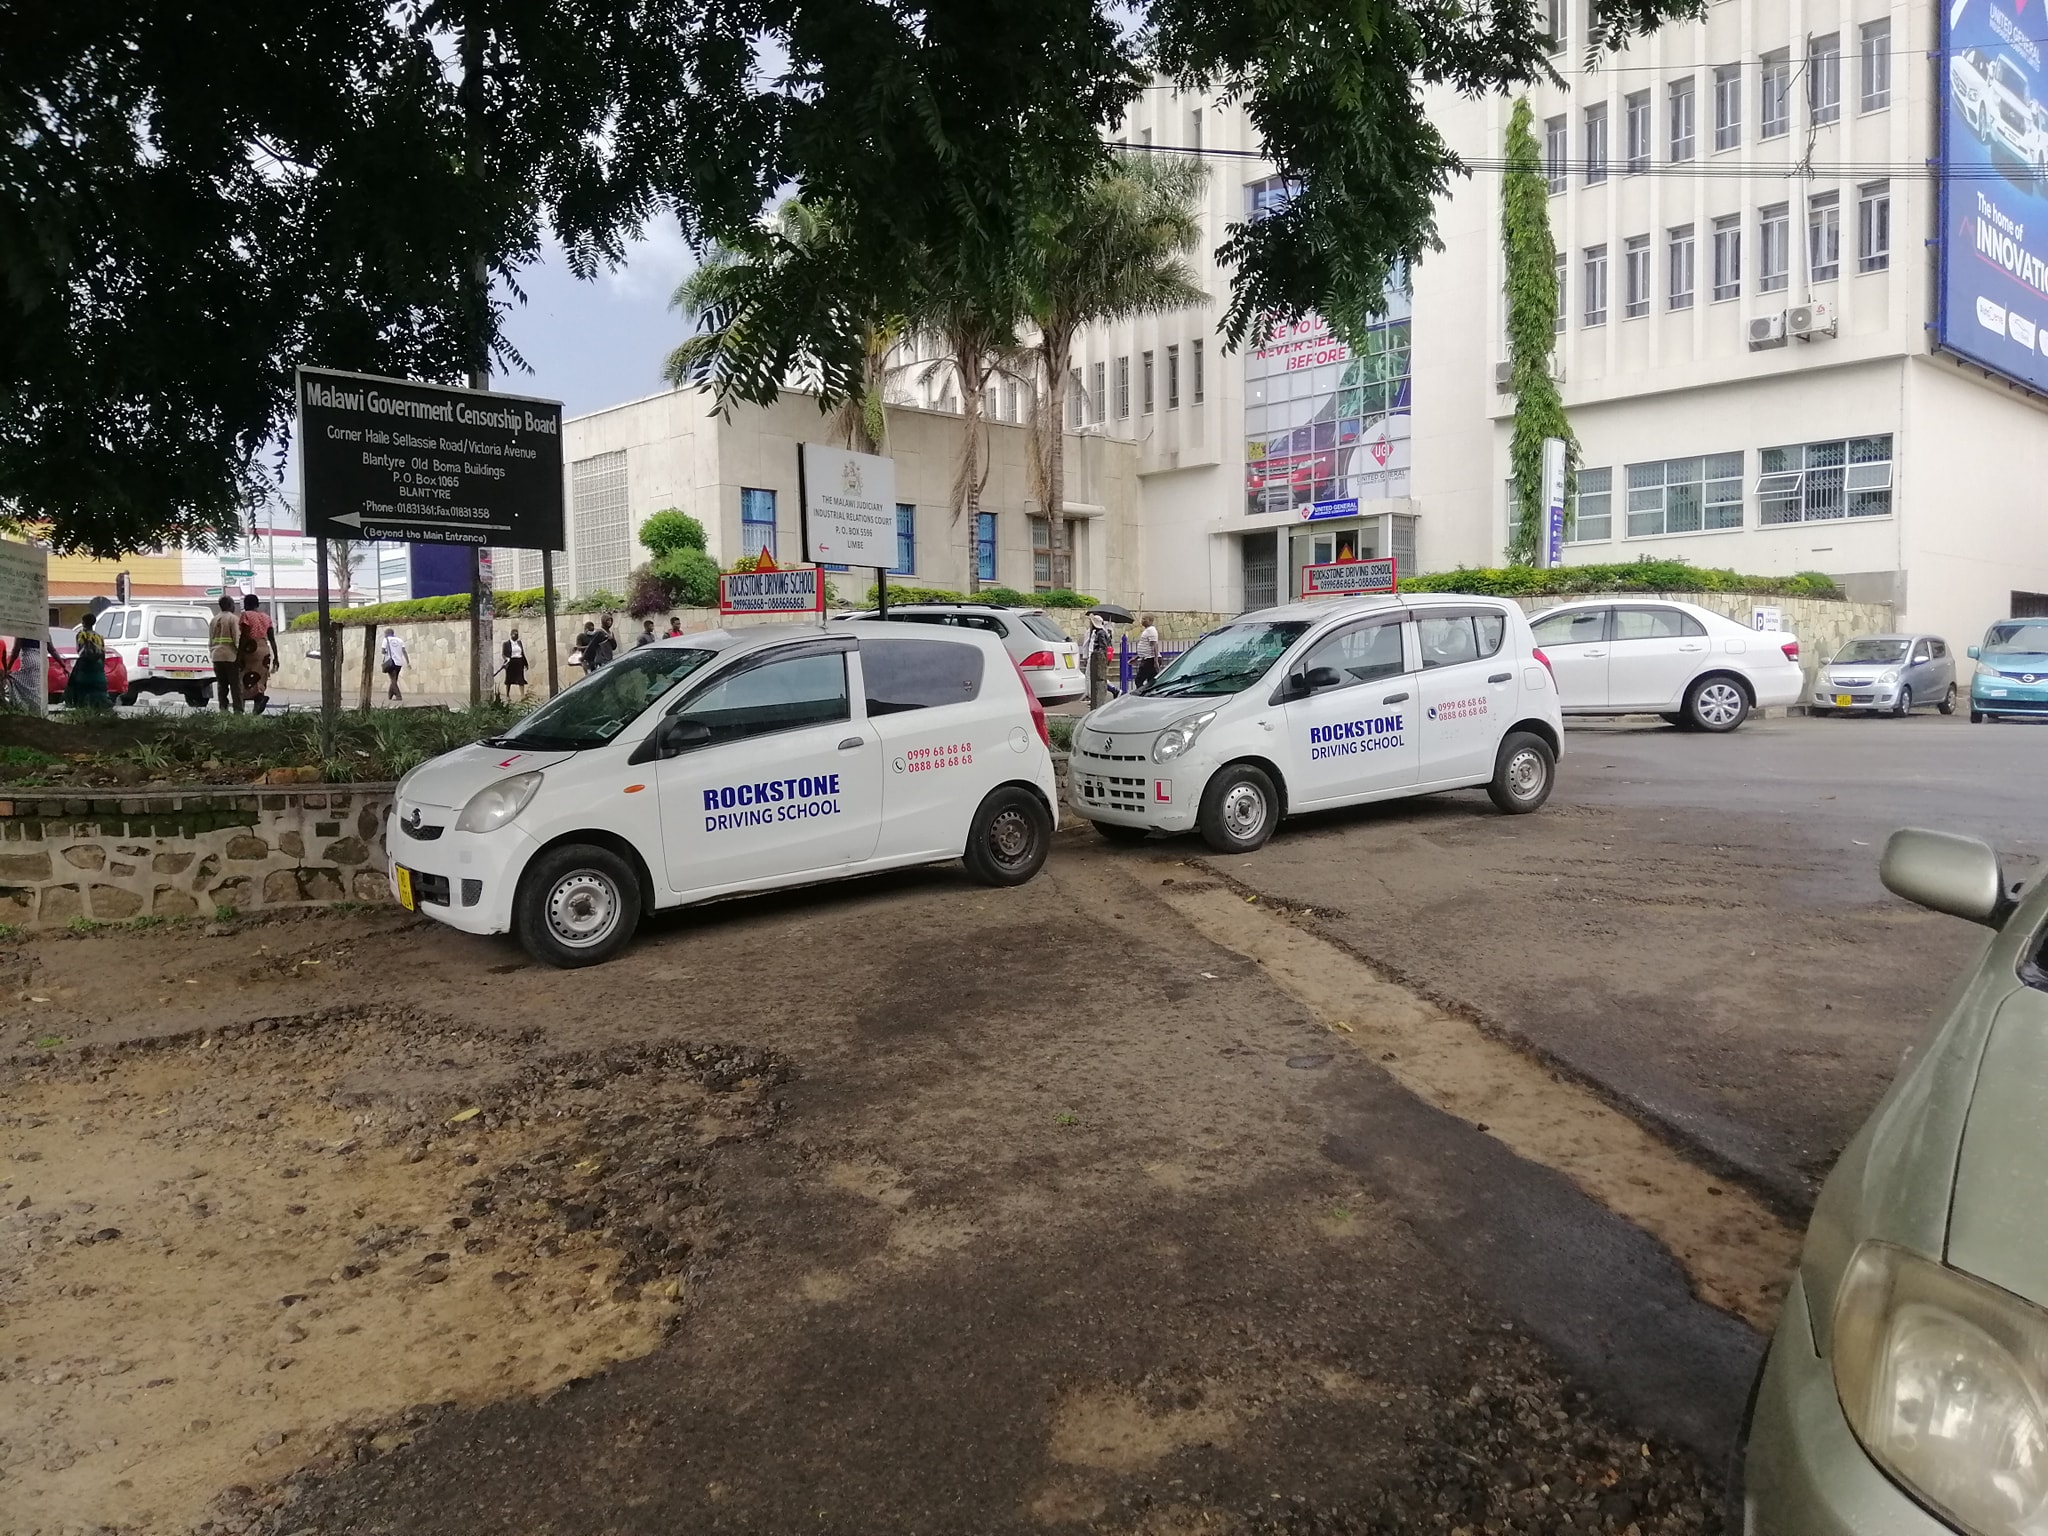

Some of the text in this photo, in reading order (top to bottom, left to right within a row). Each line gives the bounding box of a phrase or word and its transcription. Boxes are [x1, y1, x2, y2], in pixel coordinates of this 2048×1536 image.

[1977, 190, 2024, 242] The home of
[1286, 347, 1347, 371] BEFORE
[306, 381, 557, 436] Malawi Government Censorship Board
[327, 425, 362, 442] Corner
[365, 429, 390, 445] Haile
[392, 432, 437, 449] Sellassie
[504, 444, 537, 459] Avenue
[362, 452, 506, 480] Blantyre Old Boma Buildings
[399, 486, 451, 500] BLANTYRE
[822, 495, 883, 512] THE MALAWI JUDICIARY
[813, 508, 892, 526] INDUSTRIAL RELATIONS COURT
[406, 529, 421, 539] the
[423, 531, 444, 540] Main
[445, 532, 487, 545] Entrance)
[847, 540, 864, 550] LIMBE
[729, 571, 815, 597] ROCKSTONE DRIVING SCHOOL
[160, 653, 210, 664] TOYOTA
[1438, 696, 1487, 712] 0999 68 68 68
[1438, 706, 1488, 721] 0888 68 68 68
[1310, 714, 1404, 744] ROCKSTONE
[907, 742, 972, 761] 0999 68 68 68
[1311, 734, 1405, 760] DRIVING SCHOOL
[908, 754, 973, 773] 0888 68 68 68
[702, 773, 840, 811] ROCKSTONE
[1156, 781, 1170, 801] L
[705, 799, 840, 832] DRIVING SCHOOL
